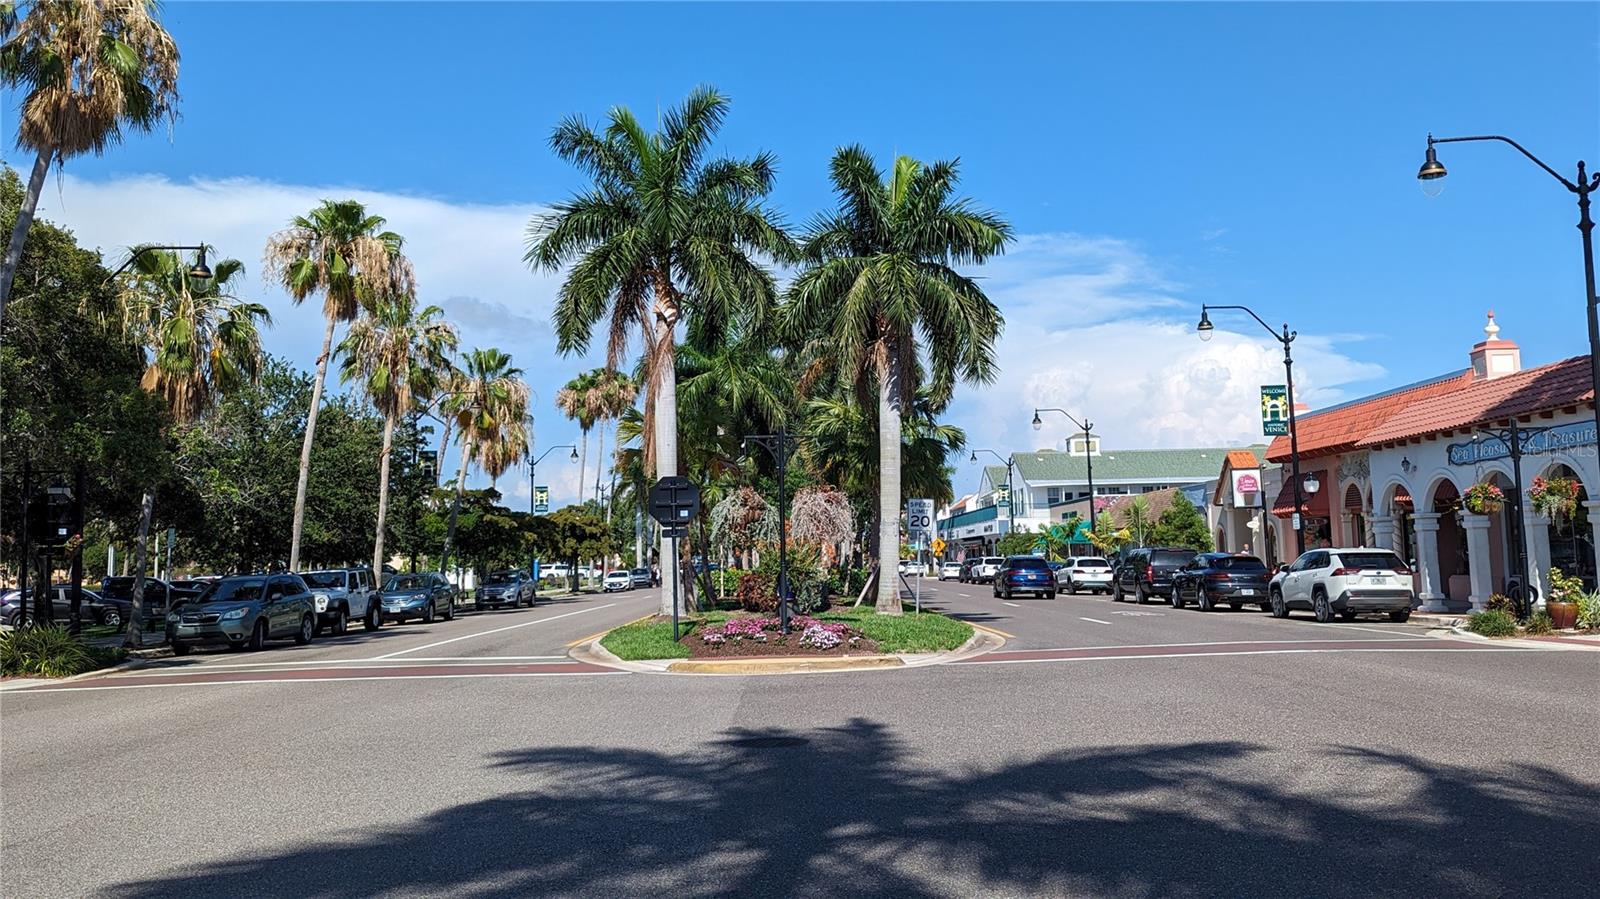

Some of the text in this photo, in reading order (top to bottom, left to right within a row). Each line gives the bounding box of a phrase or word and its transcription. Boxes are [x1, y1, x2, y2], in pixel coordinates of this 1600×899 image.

[1451, 447, 1469, 461] Sea
[1543, 429, 1597, 447] Treasure
[910, 515, 930, 527] 20
